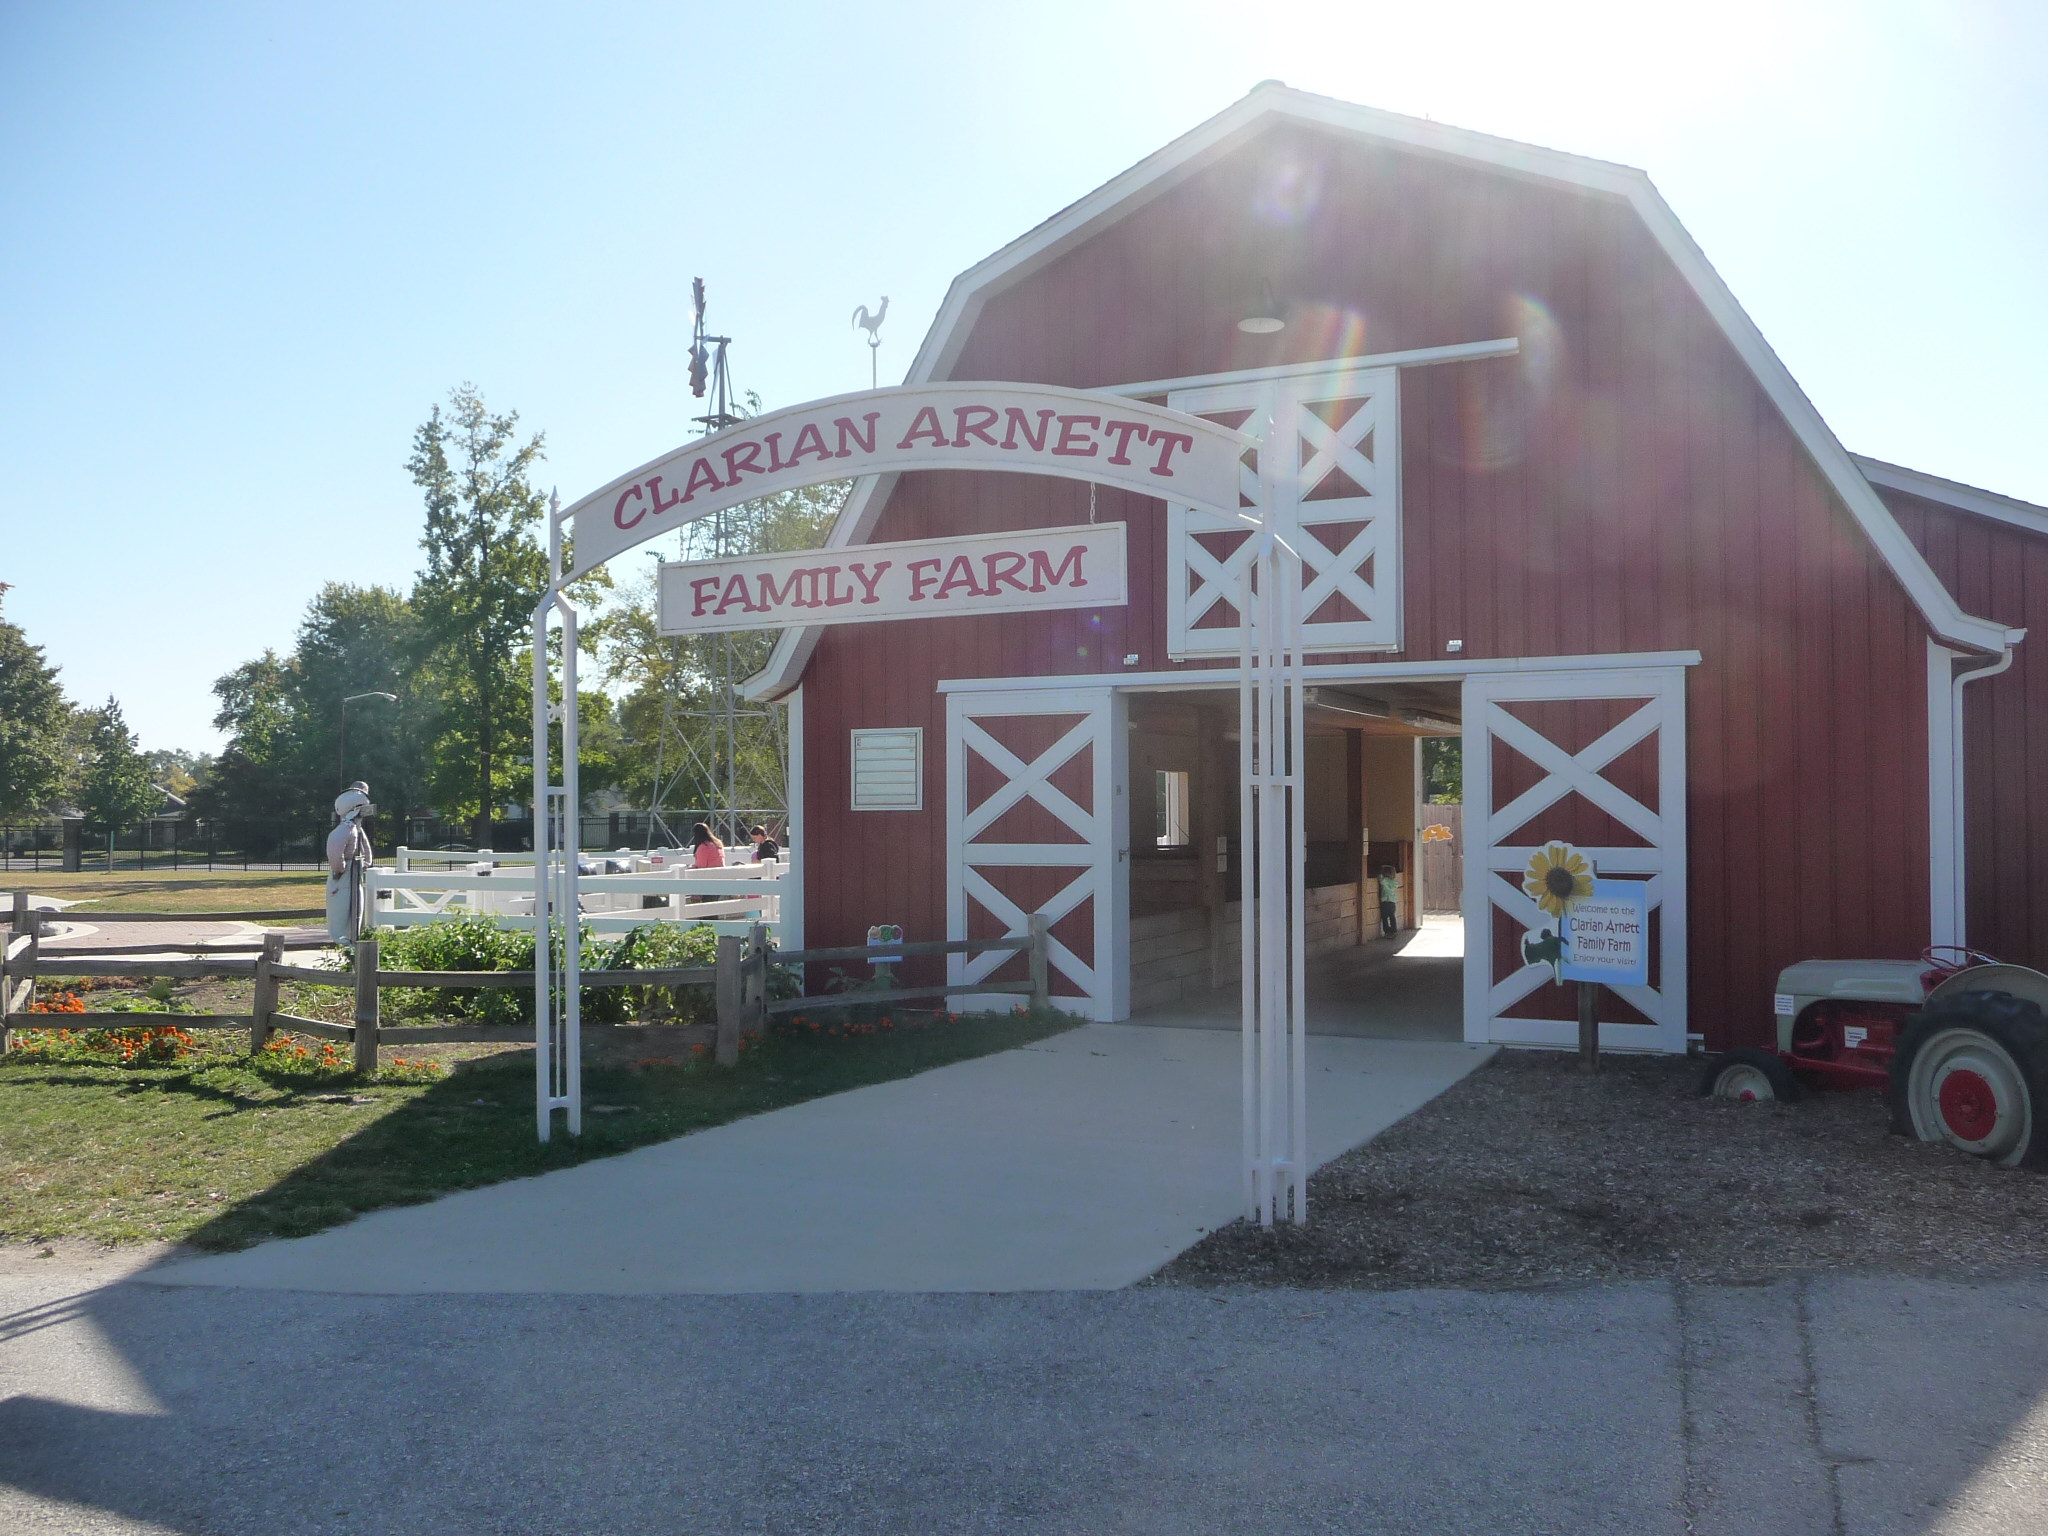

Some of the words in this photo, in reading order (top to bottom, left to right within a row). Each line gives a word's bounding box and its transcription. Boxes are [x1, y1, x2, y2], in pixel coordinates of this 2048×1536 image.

[614, 411, 881, 530] CLARIAN
[895, 405, 1194, 479] ARNETT
[690, 560, 892, 617] FAMILY
[908, 545, 1088, 601] FARM
[1572, 903, 1608, 914] Welcome
[1621, 907, 1635, 915] the
[1569, 917, 1604, 932] Clarian
[1604, 918, 1640, 934] Arnett
[1577, 935, 1606, 951] Family
[1607, 938, 1631, 953] Farm
[1573, 953, 1595, 962] Enjoy
[1597, 956, 1615, 964] your
